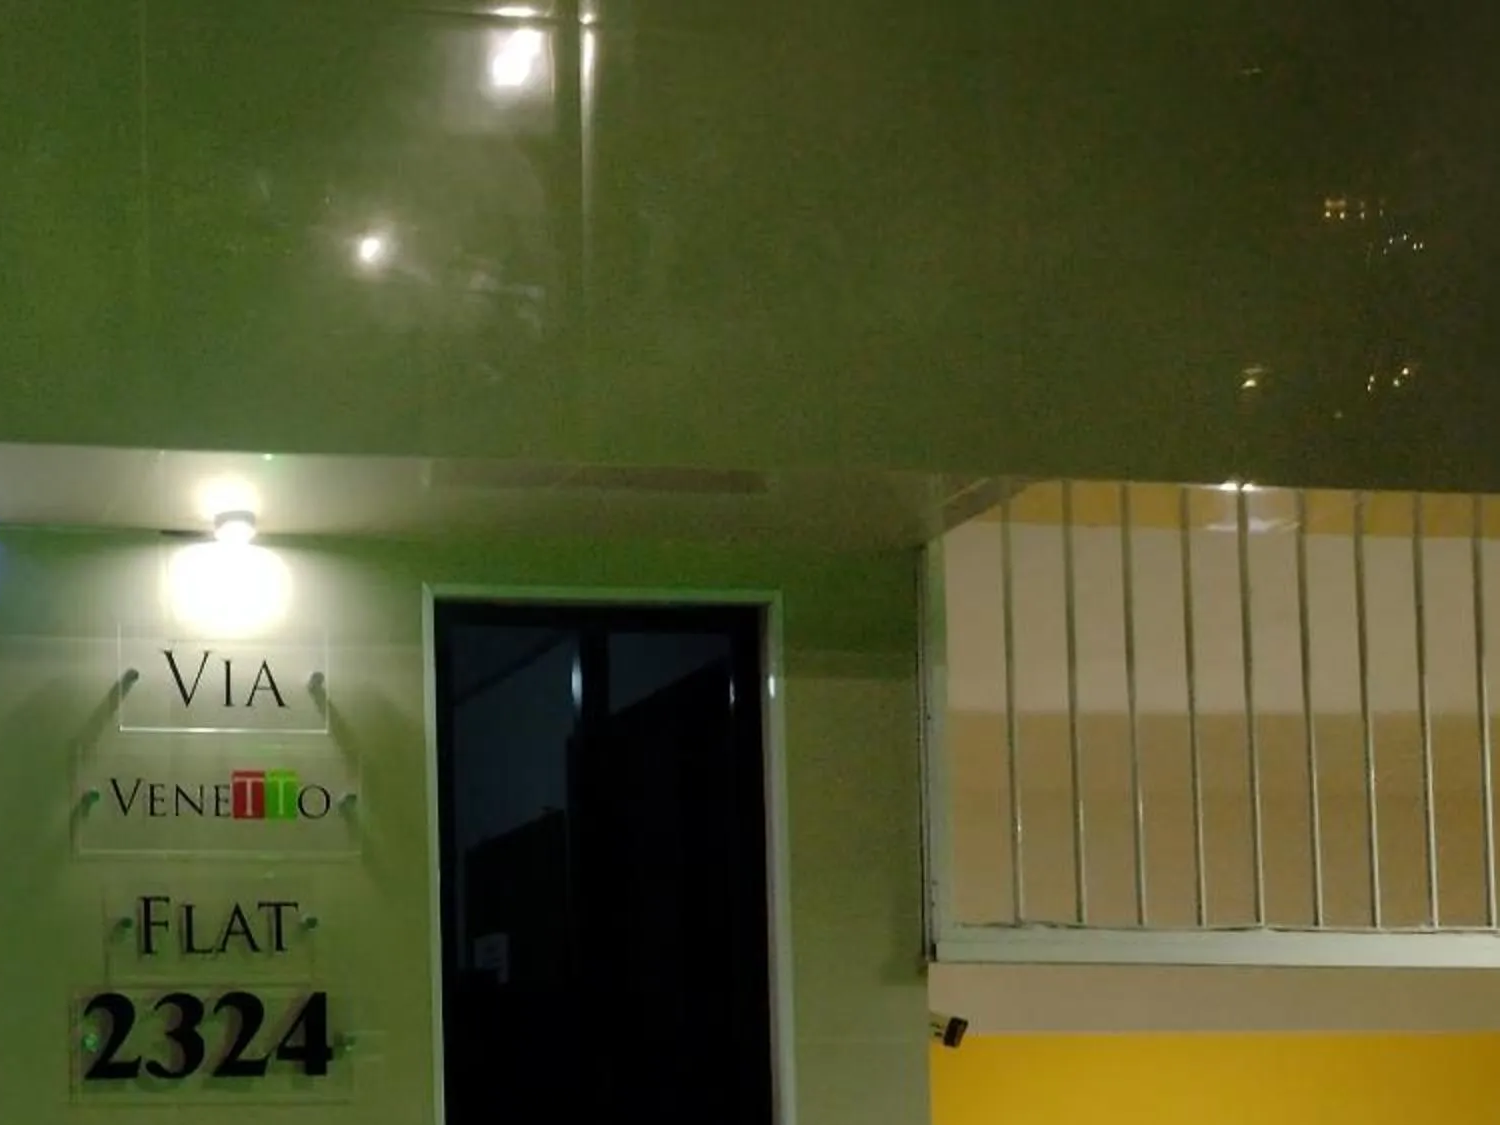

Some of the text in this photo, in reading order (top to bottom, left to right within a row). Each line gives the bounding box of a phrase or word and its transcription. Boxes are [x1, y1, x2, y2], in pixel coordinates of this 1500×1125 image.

[162, 650, 287, 708] VIA
[109, 774, 331, 819] VENETTO
[139, 895, 299, 955] FLAT
[83, 991, 334, 1080] 2324
